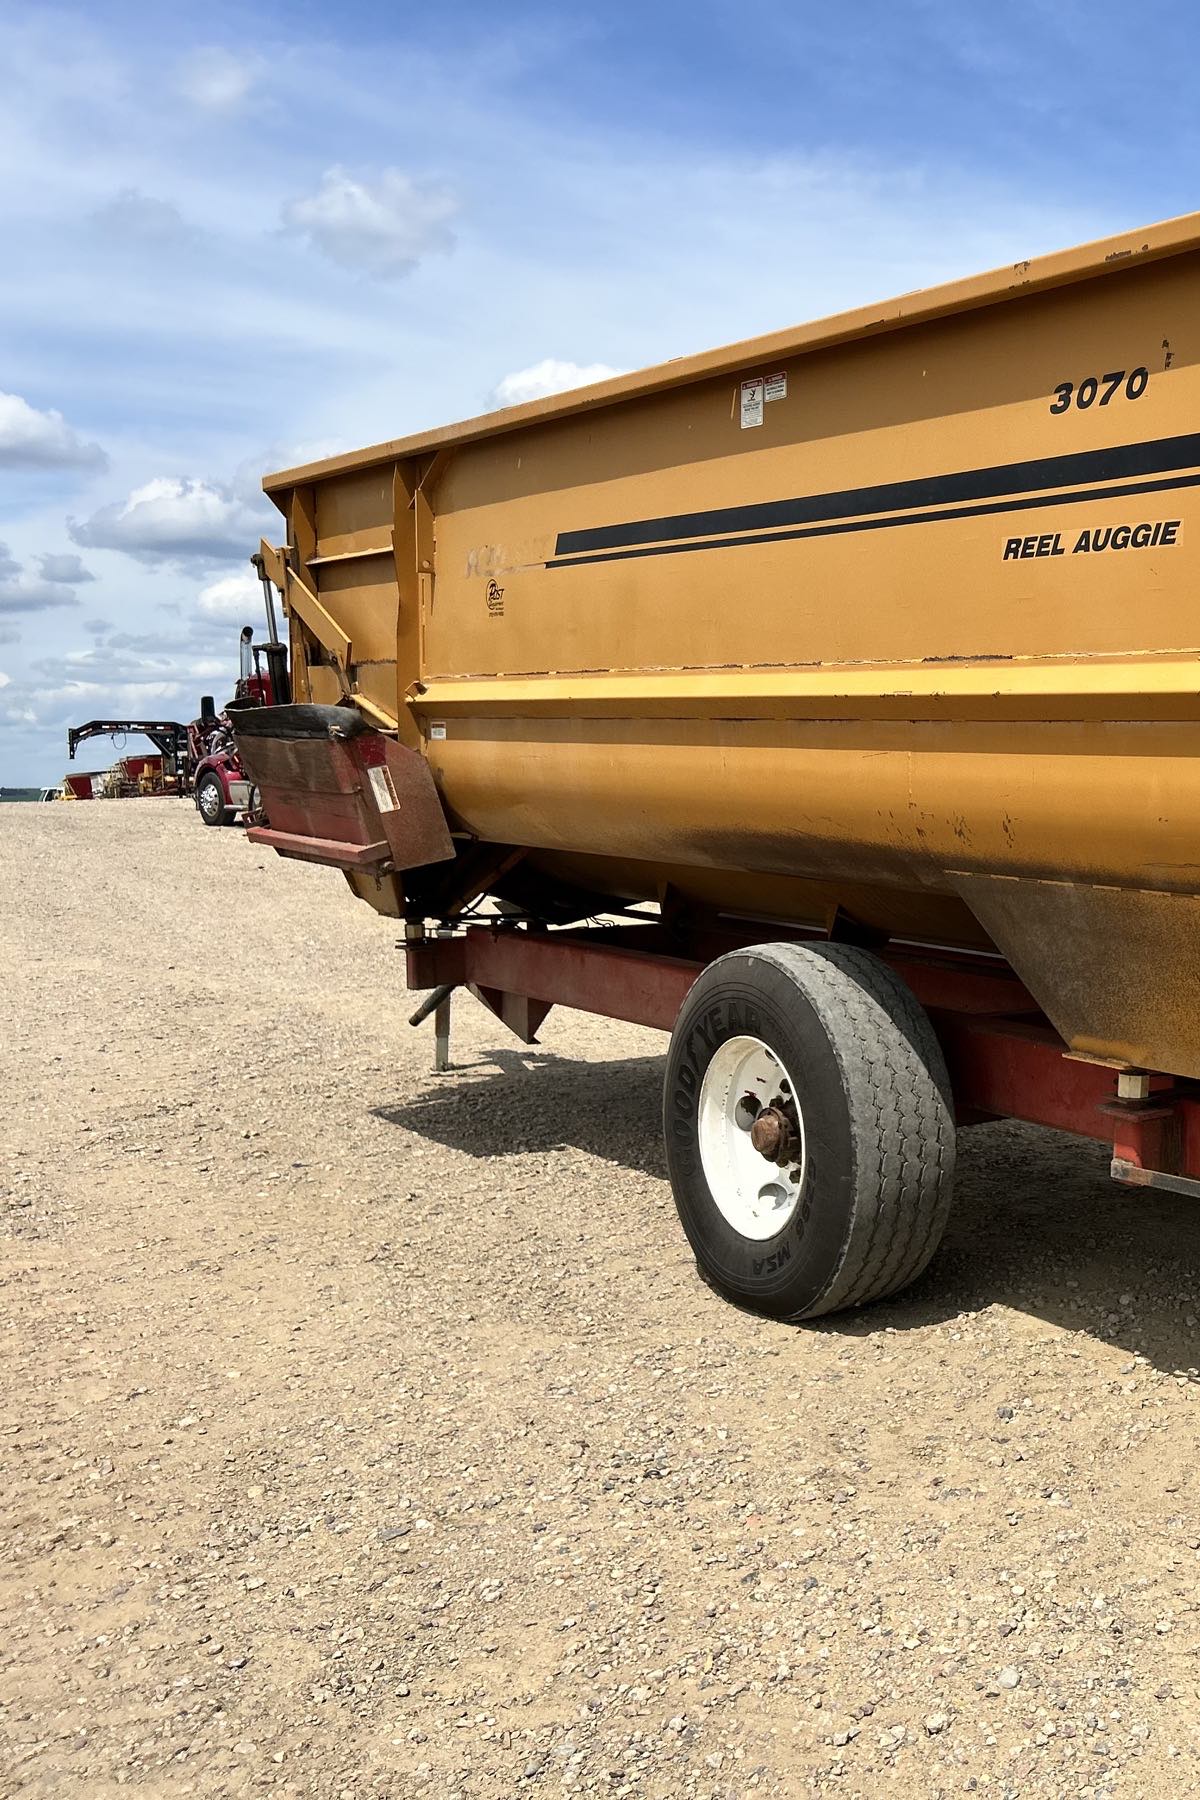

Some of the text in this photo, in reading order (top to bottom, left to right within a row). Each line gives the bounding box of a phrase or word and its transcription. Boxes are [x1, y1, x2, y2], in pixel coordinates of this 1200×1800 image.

[1049, 367, 1149, 415] 3070
[1003, 520, 1181, 561] REEL AUGGIE
[672, 1001, 764, 1178] GOODYEAR
[751, 1240, 792, 1275] MSA
